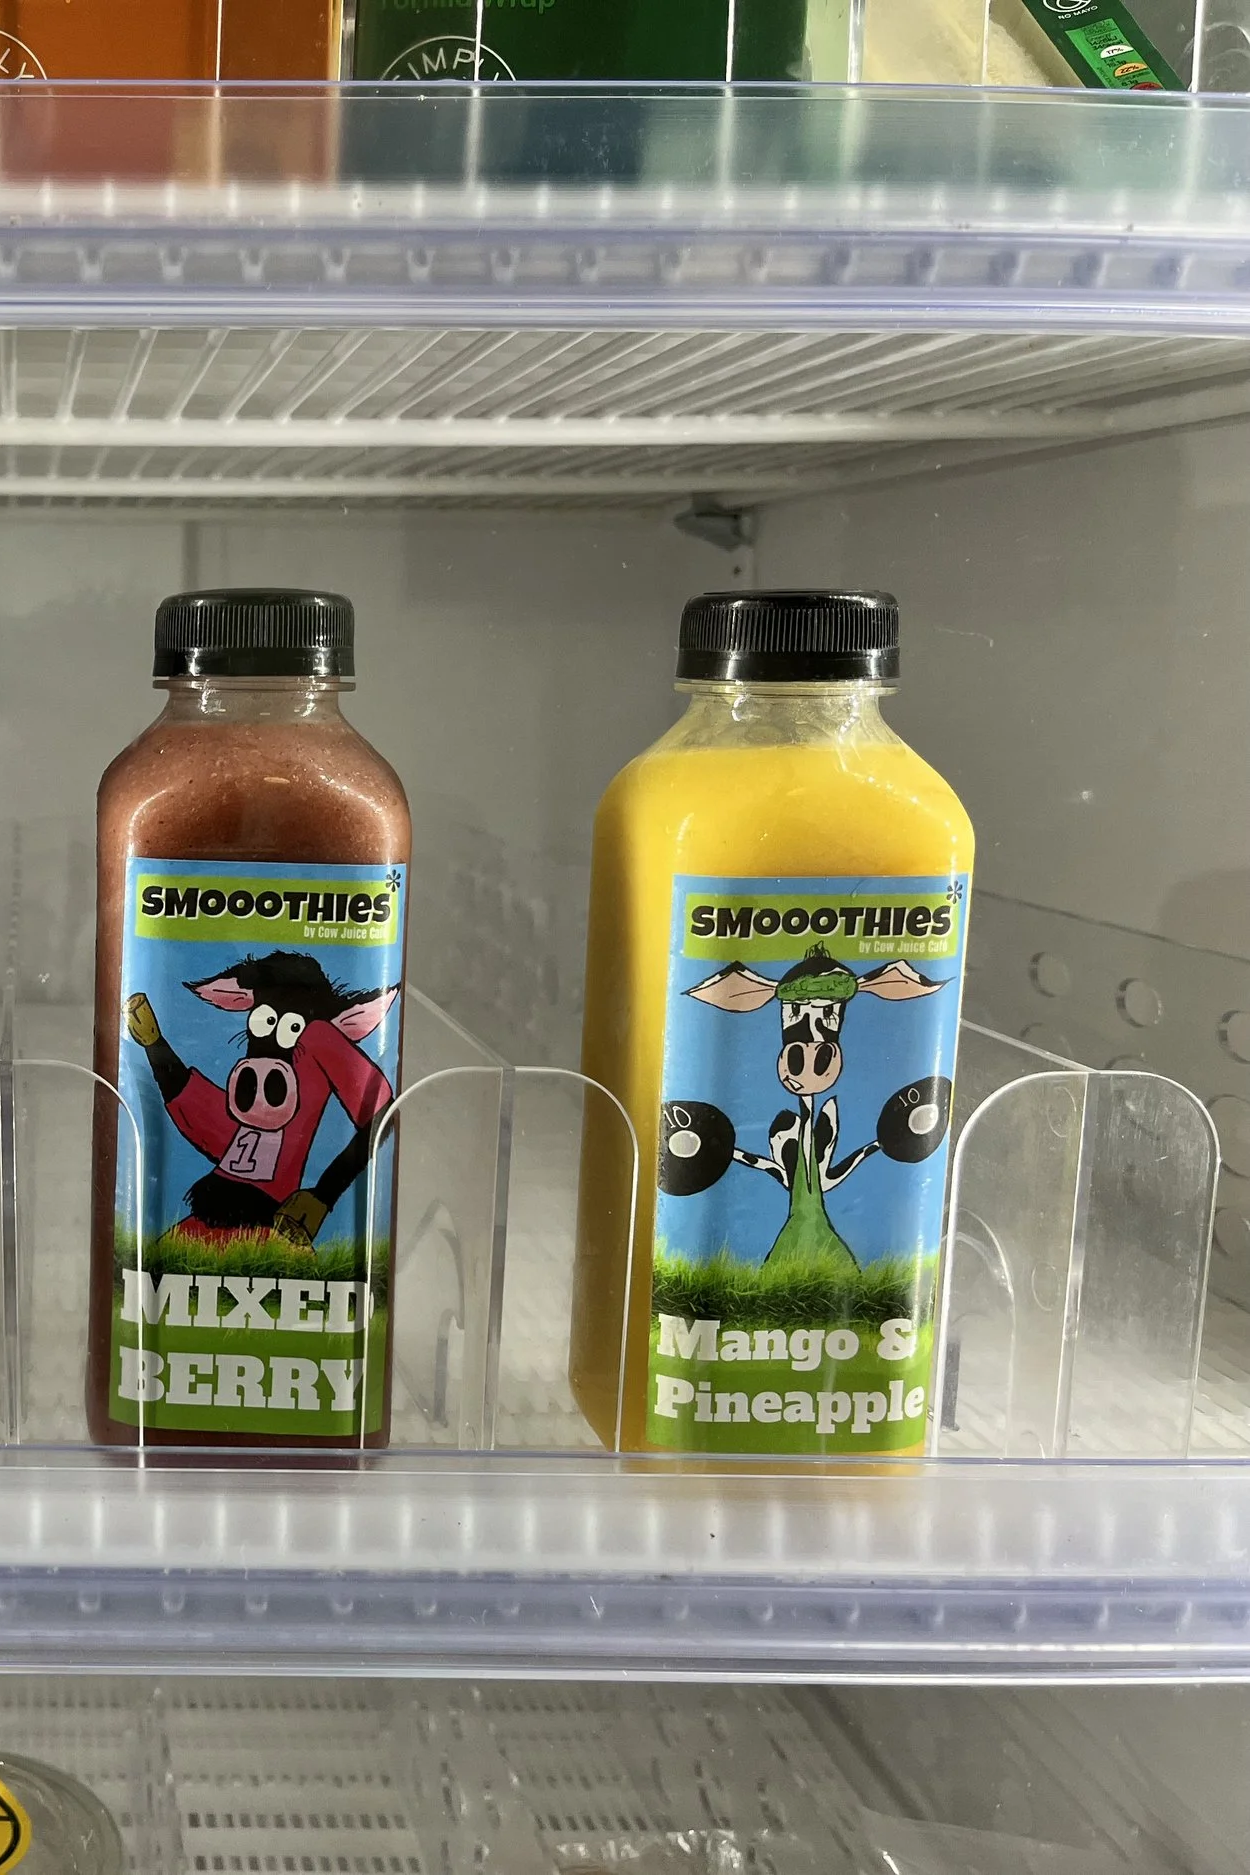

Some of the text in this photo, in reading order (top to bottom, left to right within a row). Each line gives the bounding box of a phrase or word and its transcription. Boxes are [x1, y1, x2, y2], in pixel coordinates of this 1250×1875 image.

[1073, 5, 1098, 17] MAYO
[392, 47, 500, 81] IMP
[304, 925, 390, 940] by Cow Juice Ca
[859, 941, 871, 954] by
[874, 940, 895, 952] Cow
[897, 941, 926, 953] Juice
[898, 1087, 920, 1108] 10
[664, 1105, 692, 1129] 10
[230, 1131, 261, 1173] 1
[120, 1268, 374, 1333] MIXED
[657, 1313, 918, 1371] Mango &
[118, 1345, 364, 1411] BERRY
[654, 1373, 925, 1434] Pineapple
